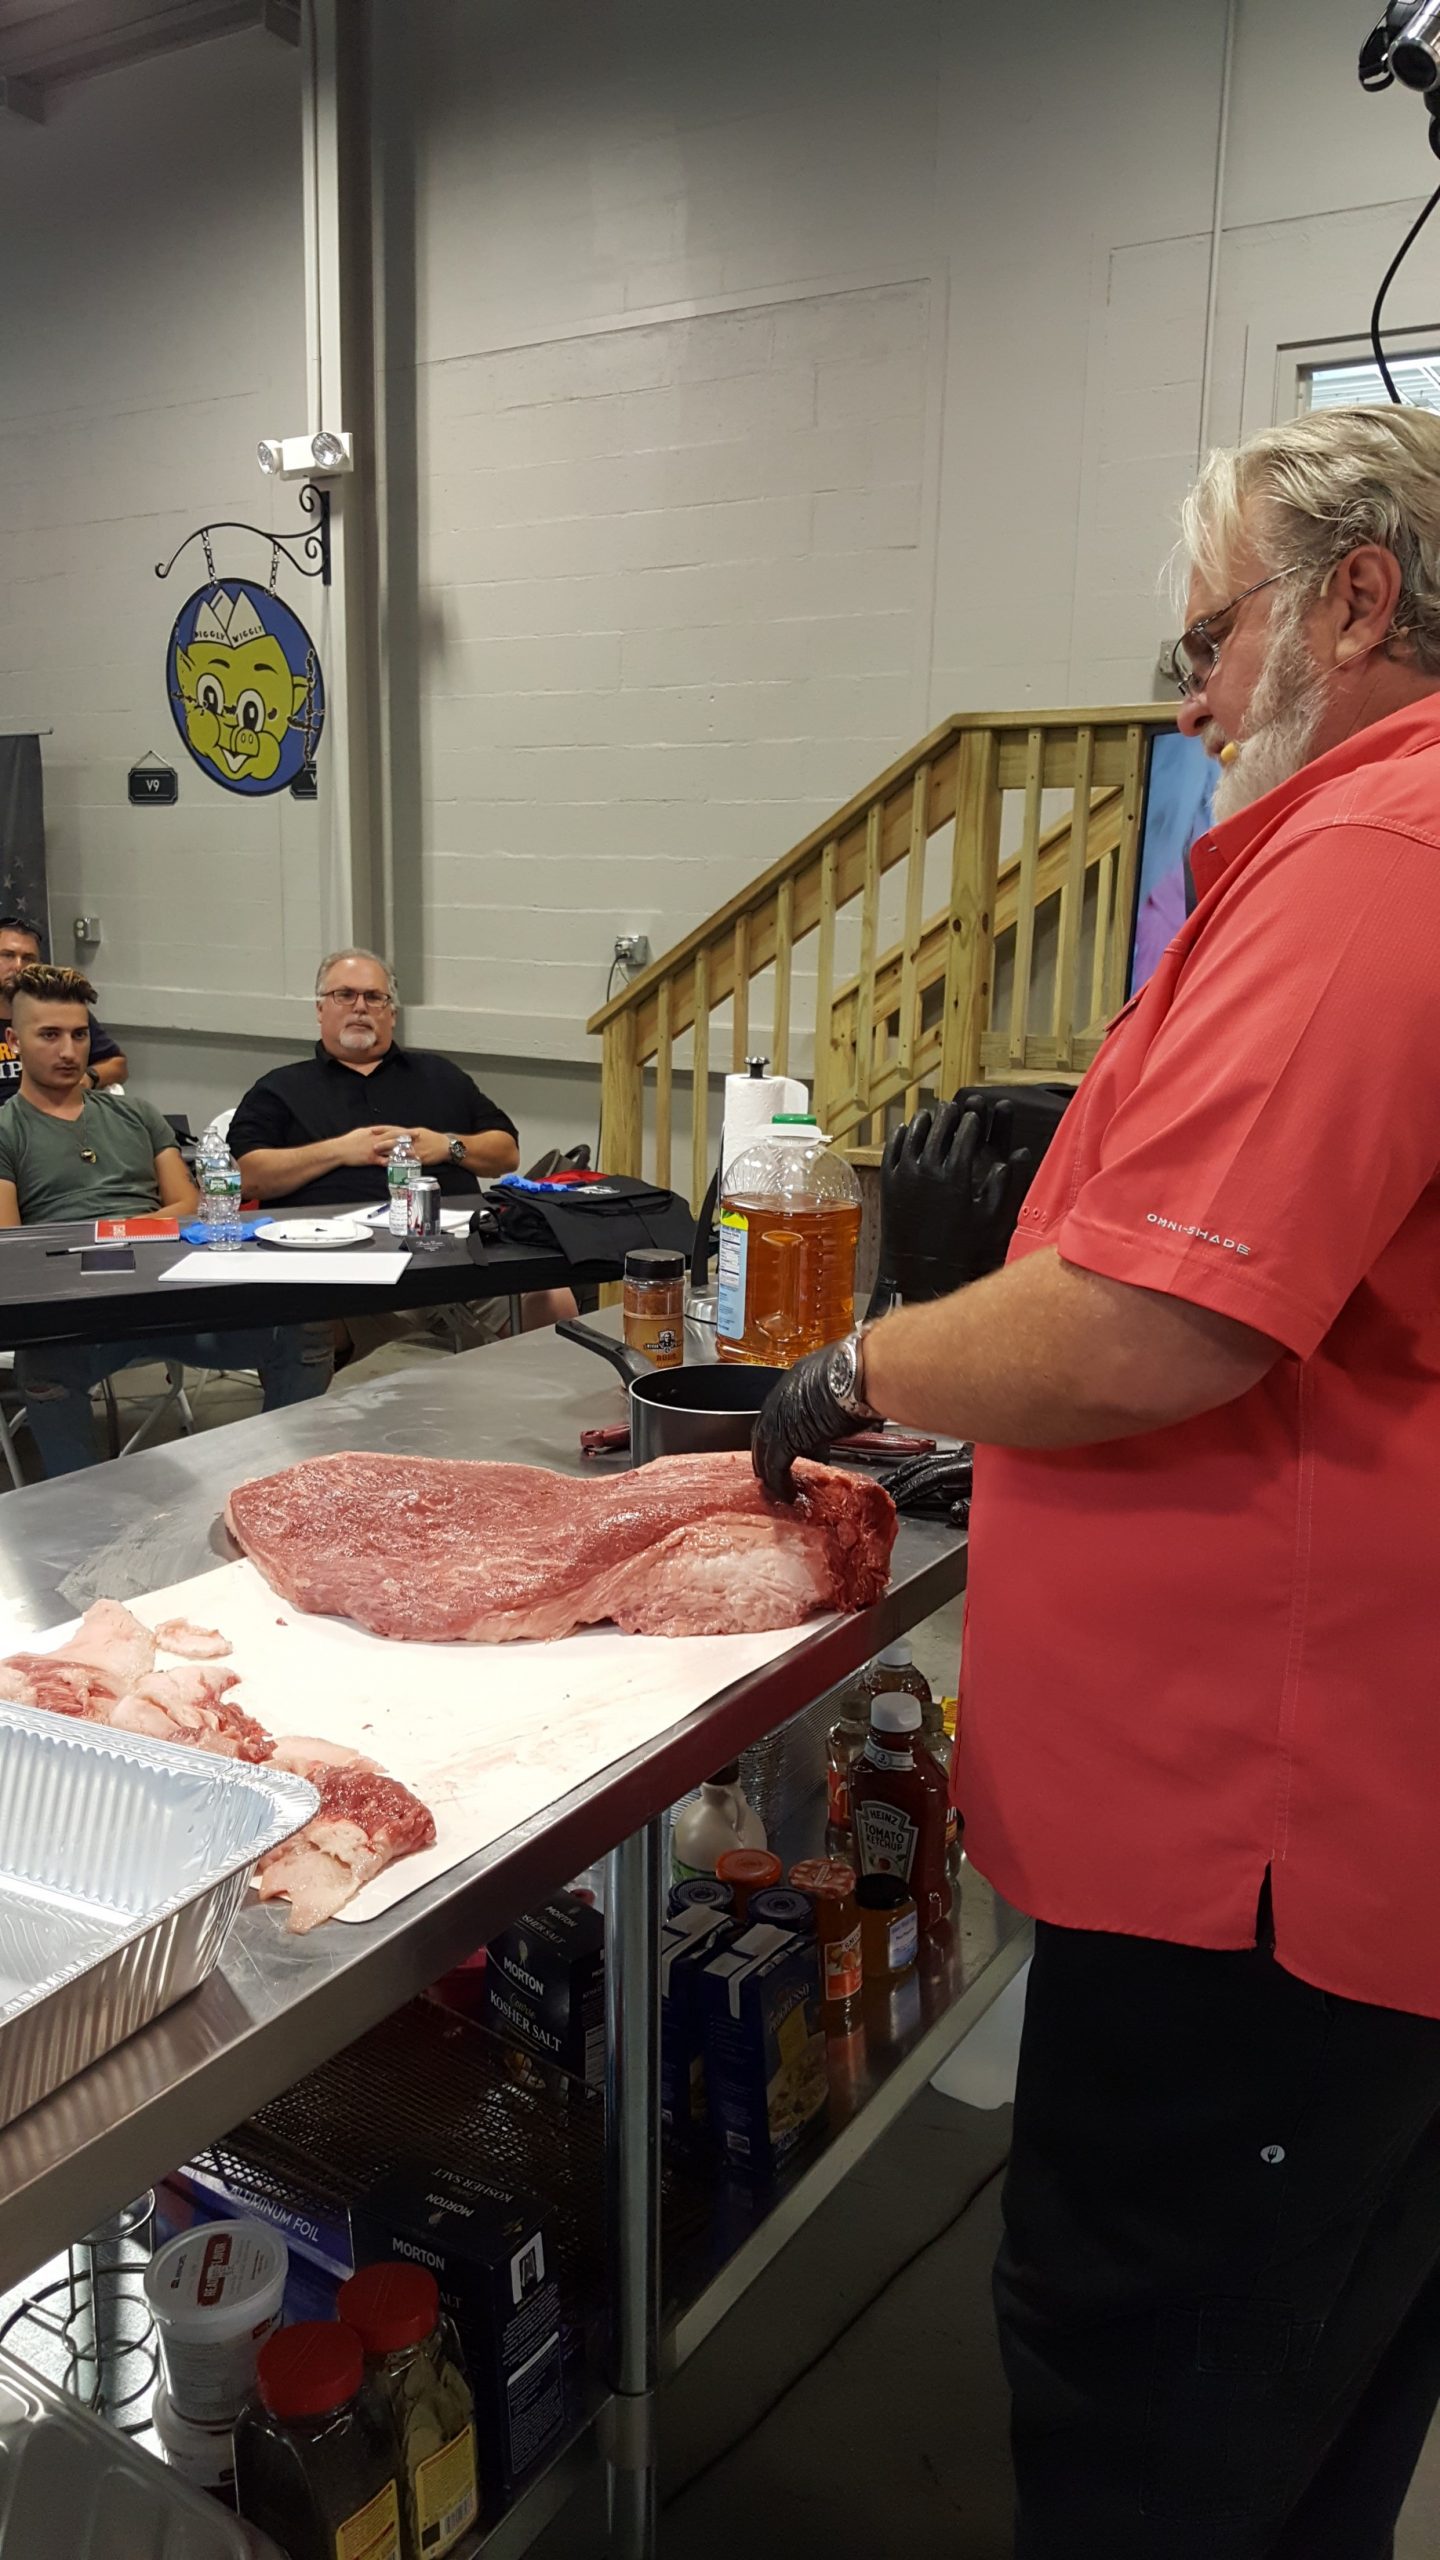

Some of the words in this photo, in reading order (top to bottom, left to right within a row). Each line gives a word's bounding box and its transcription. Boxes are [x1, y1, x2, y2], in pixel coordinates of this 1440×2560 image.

[232, 625, 263, 643] WIGGLY
[146, 779, 160, 792] V9
[1147, 1213, 1251, 1256] OMNI-SHADE
[869, 1810, 899, 1826] HEINZ
[864, 1821, 905, 1844] TOMATO
[866, 1834, 903, 1852] KETCHUP
[544, 1906, 579, 1928] MORTON
[503, 1956, 544, 1996] MORTON
[490, 1989, 532, 2035] KOSHER
[532, 2024, 562, 2052] SALT
[431, 2167, 463, 2184] SALT
[463, 2178, 515, 2203] KOSHER
[230, 2185, 292, 2226] ALUMINUM
[293, 2217, 319, 2242] FOIL
[425, 2193, 475, 2218] MORTON
[392, 2237, 446, 2271] MORTON
